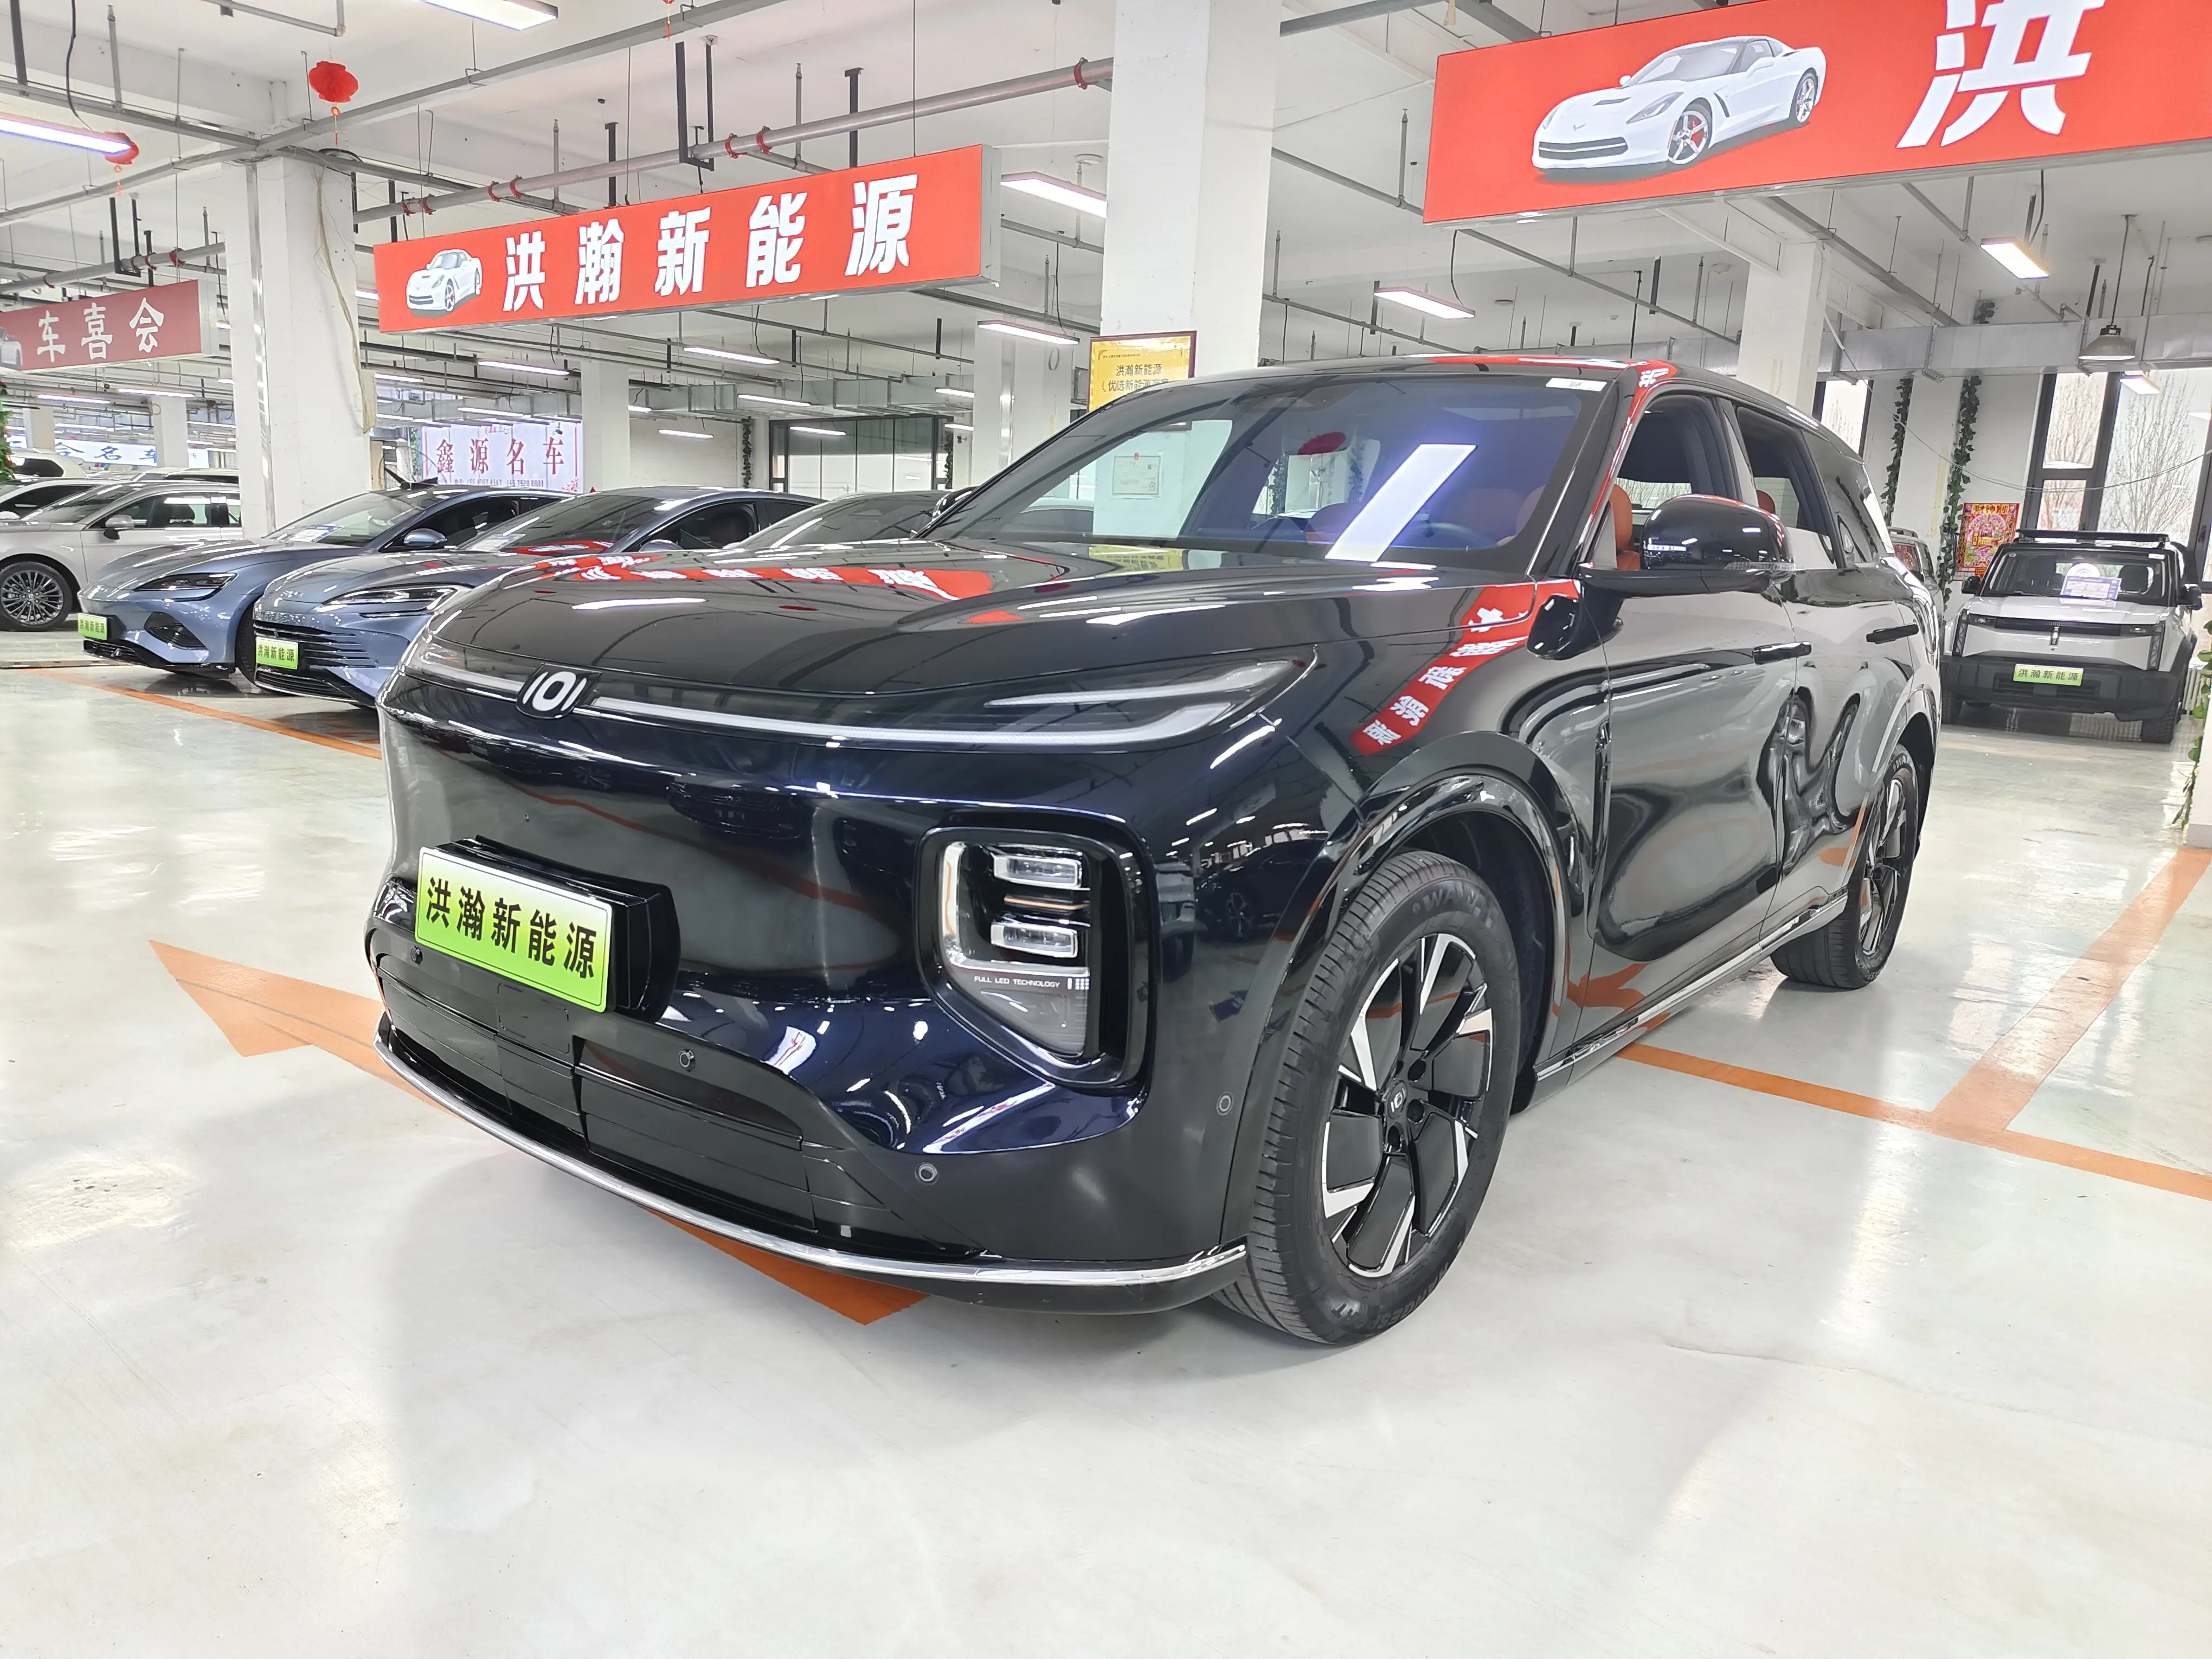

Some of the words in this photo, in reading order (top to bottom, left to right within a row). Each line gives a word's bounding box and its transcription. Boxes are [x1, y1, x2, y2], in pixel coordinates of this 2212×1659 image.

[1896, 0, 2105, 148] 洪
[502, 173, 918, 312] 洪瀚新能源
[37, 297, 164, 363] 车喜会
[1116, 364, 1162, 376] 洪瀚新能源
[436, 436, 564, 475] 鑫源名车
[2018, 668, 2079, 681] 洪瀚新能源
[426, 876, 597, 979] 洪瀚新能源
[1012, 979, 1061, 988] TECHNOLOGY
